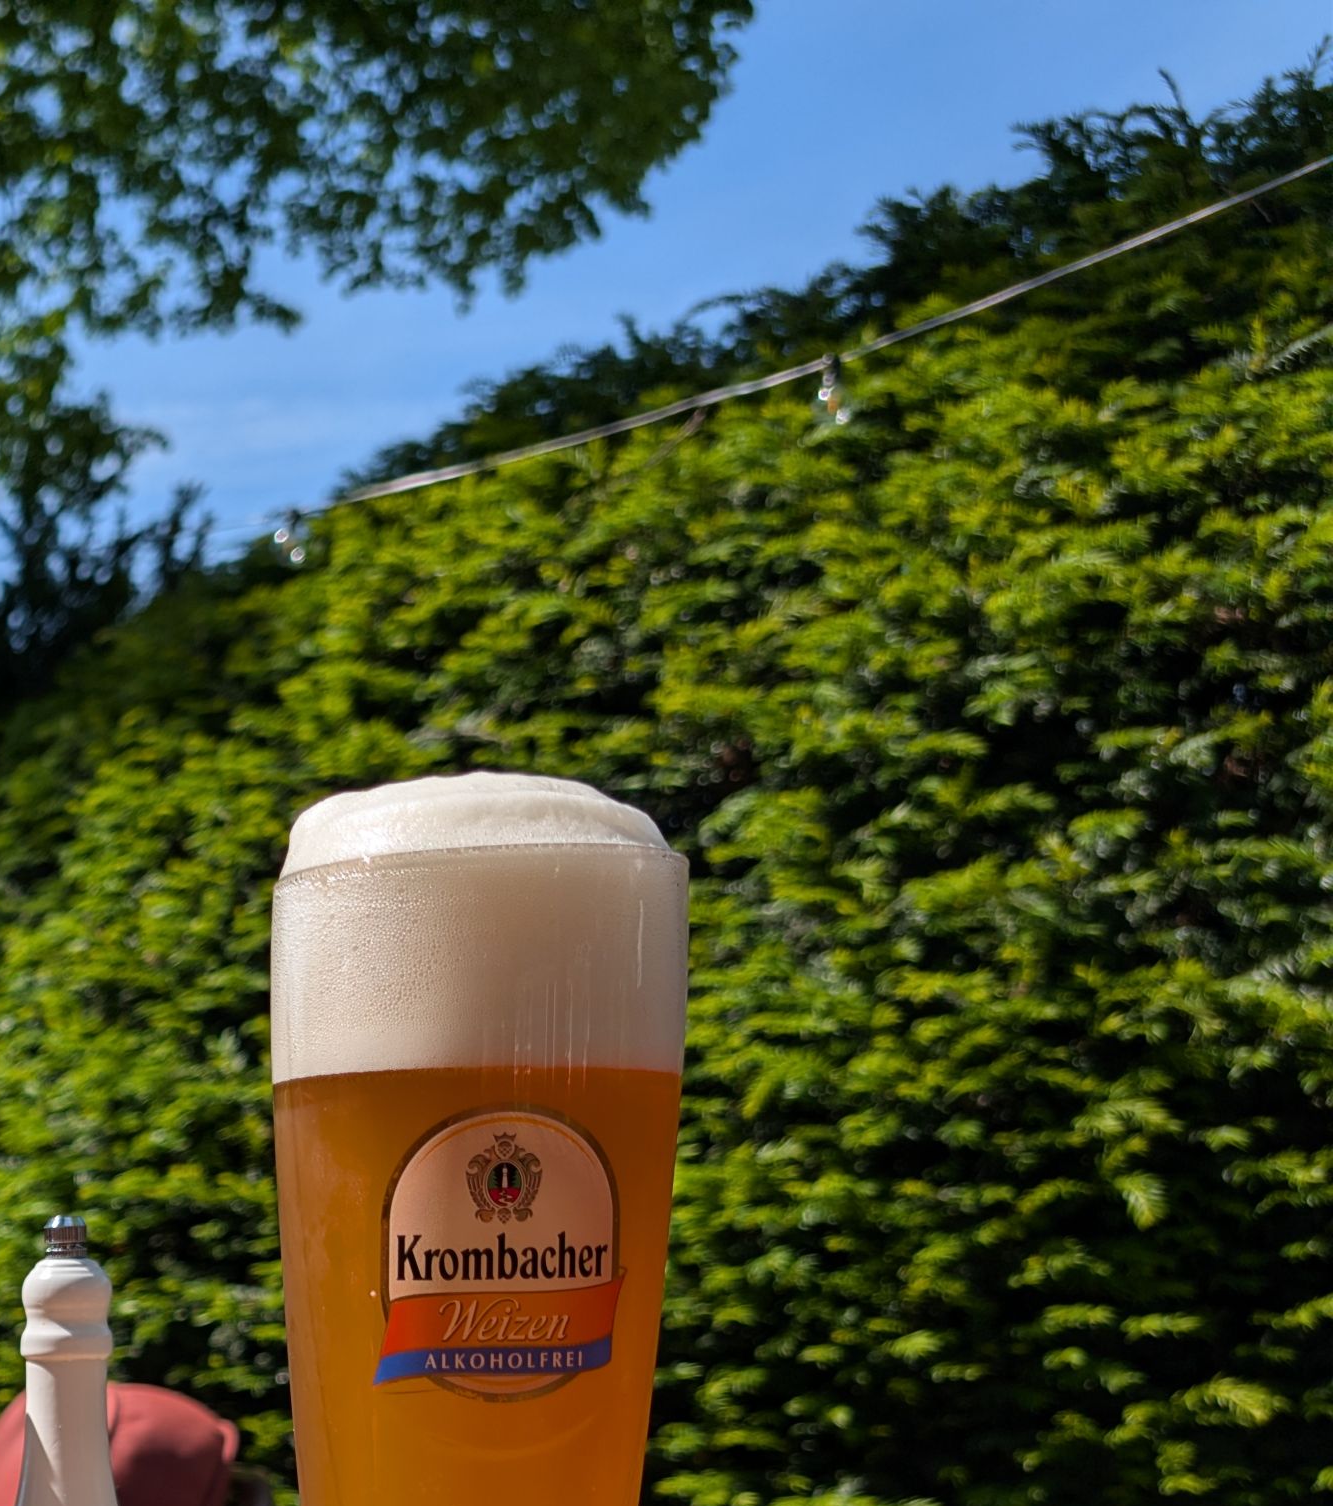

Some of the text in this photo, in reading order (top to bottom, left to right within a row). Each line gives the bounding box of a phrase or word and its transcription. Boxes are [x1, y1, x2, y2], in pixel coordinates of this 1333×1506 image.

[396, 1231, 608, 1281] Krombacher
[438, 1298, 570, 1342] Weizen
[425, 1350, 583, 1370] ALKOHOLFREI
